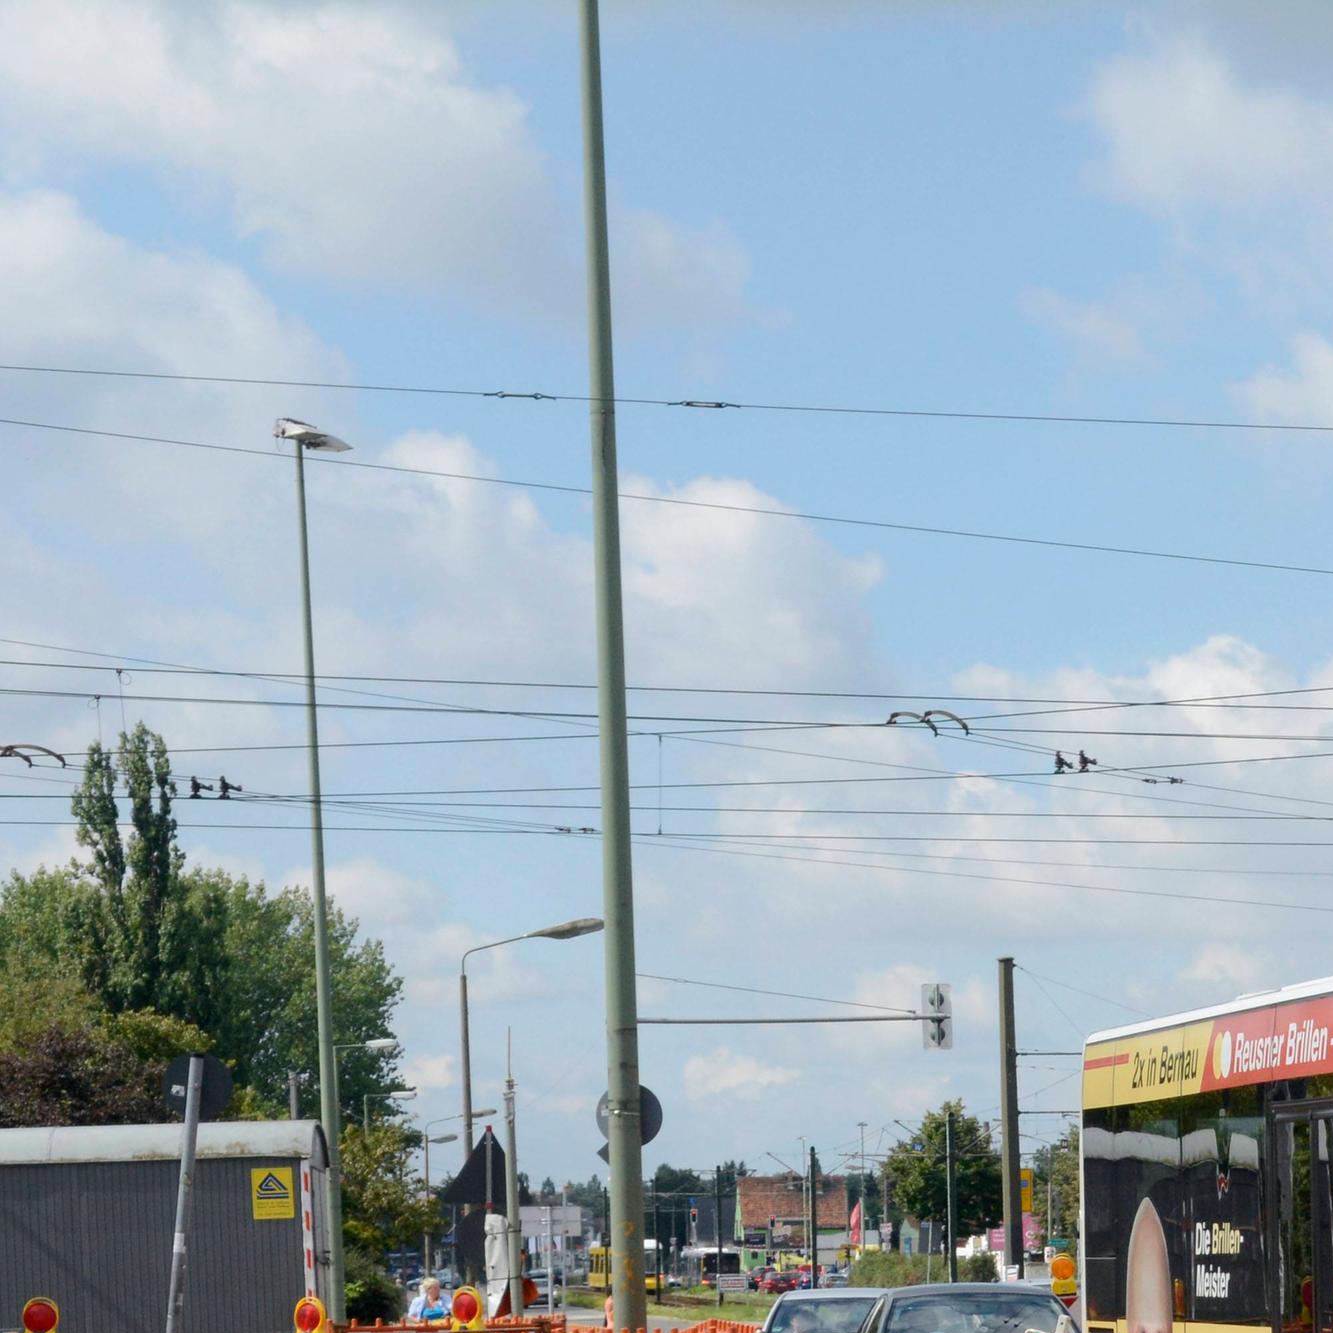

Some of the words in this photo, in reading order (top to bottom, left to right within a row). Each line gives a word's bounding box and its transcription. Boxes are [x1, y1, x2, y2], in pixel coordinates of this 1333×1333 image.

[1132, 1050, 1144, 1089] 2x
[1146, 1049, 1156, 1084] in
[1158, 1045, 1199, 1082] Bernau
[1233, 1032, 1284, 1074] Reusner
[1284, 1022, 1328, 1066] Brillen
[1195, 1222, 1211, 1256] Die
[1212, 1222, 1244, 1255] Brillen-
[1196, 1265, 1230, 1299] Meister
